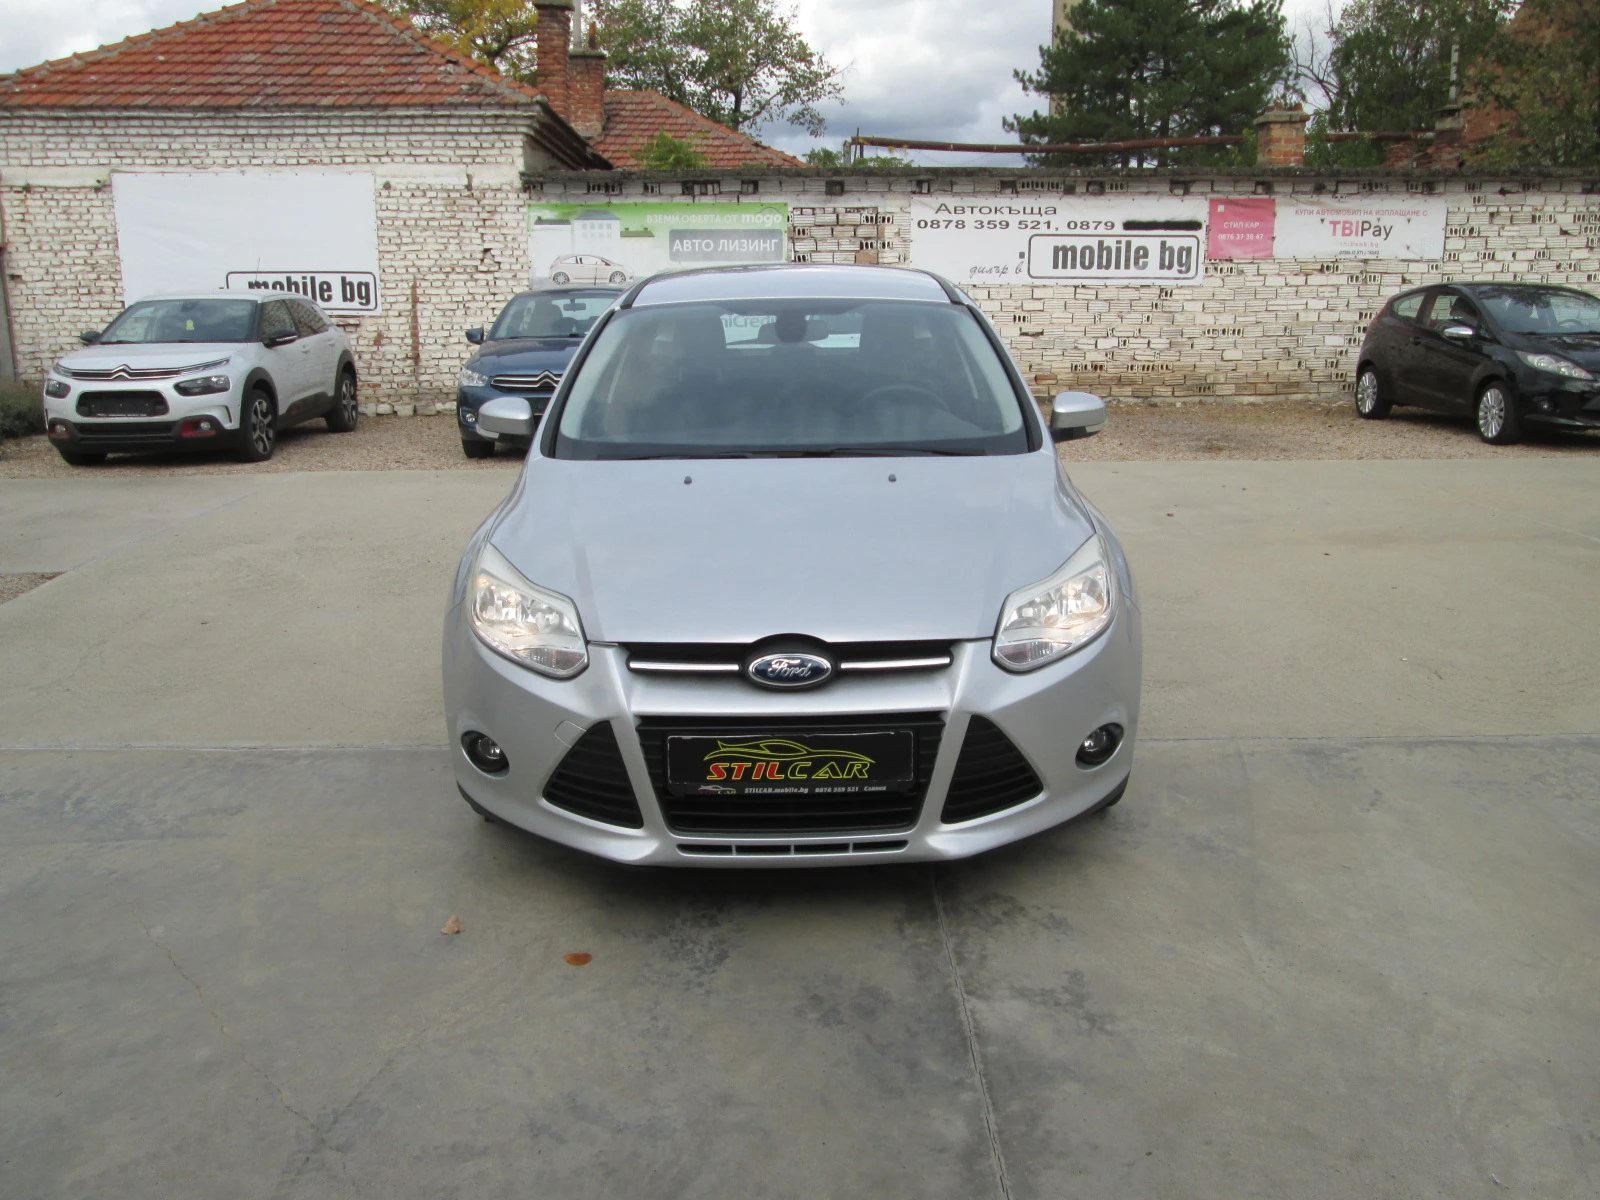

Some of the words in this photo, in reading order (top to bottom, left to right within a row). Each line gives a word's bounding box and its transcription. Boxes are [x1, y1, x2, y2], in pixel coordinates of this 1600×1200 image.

[935, 203, 1057, 215] Автокъща
[1375, 209, 1421, 217] ИЗПЛАЩАНЕ
[646, 214, 680, 224] ВЗЕМИ
[681, 214, 721, 224] ОФЕРТА
[722, 214, 739, 224] ОТ
[741, 213, 783, 227] mogo
[917, 219, 966, 230] 0878
[974, 219, 1010, 230] 359
[1017, 219, 1059, 231] 521,
[1067, 220, 1116, 230] 0879
[1329, 220, 1394, 241] TBIPay
[672, 239, 714, 252] АВТО
[717, 239, 779, 252] ЛИЗИНГ
[1052, 239, 1149, 271] mobile
[1158, 240, 1193, 274] bg
[340, 275, 371, 306] bg
[767, 658, 812, 677] Ford
[706, 761, 870, 780] STILCAR
